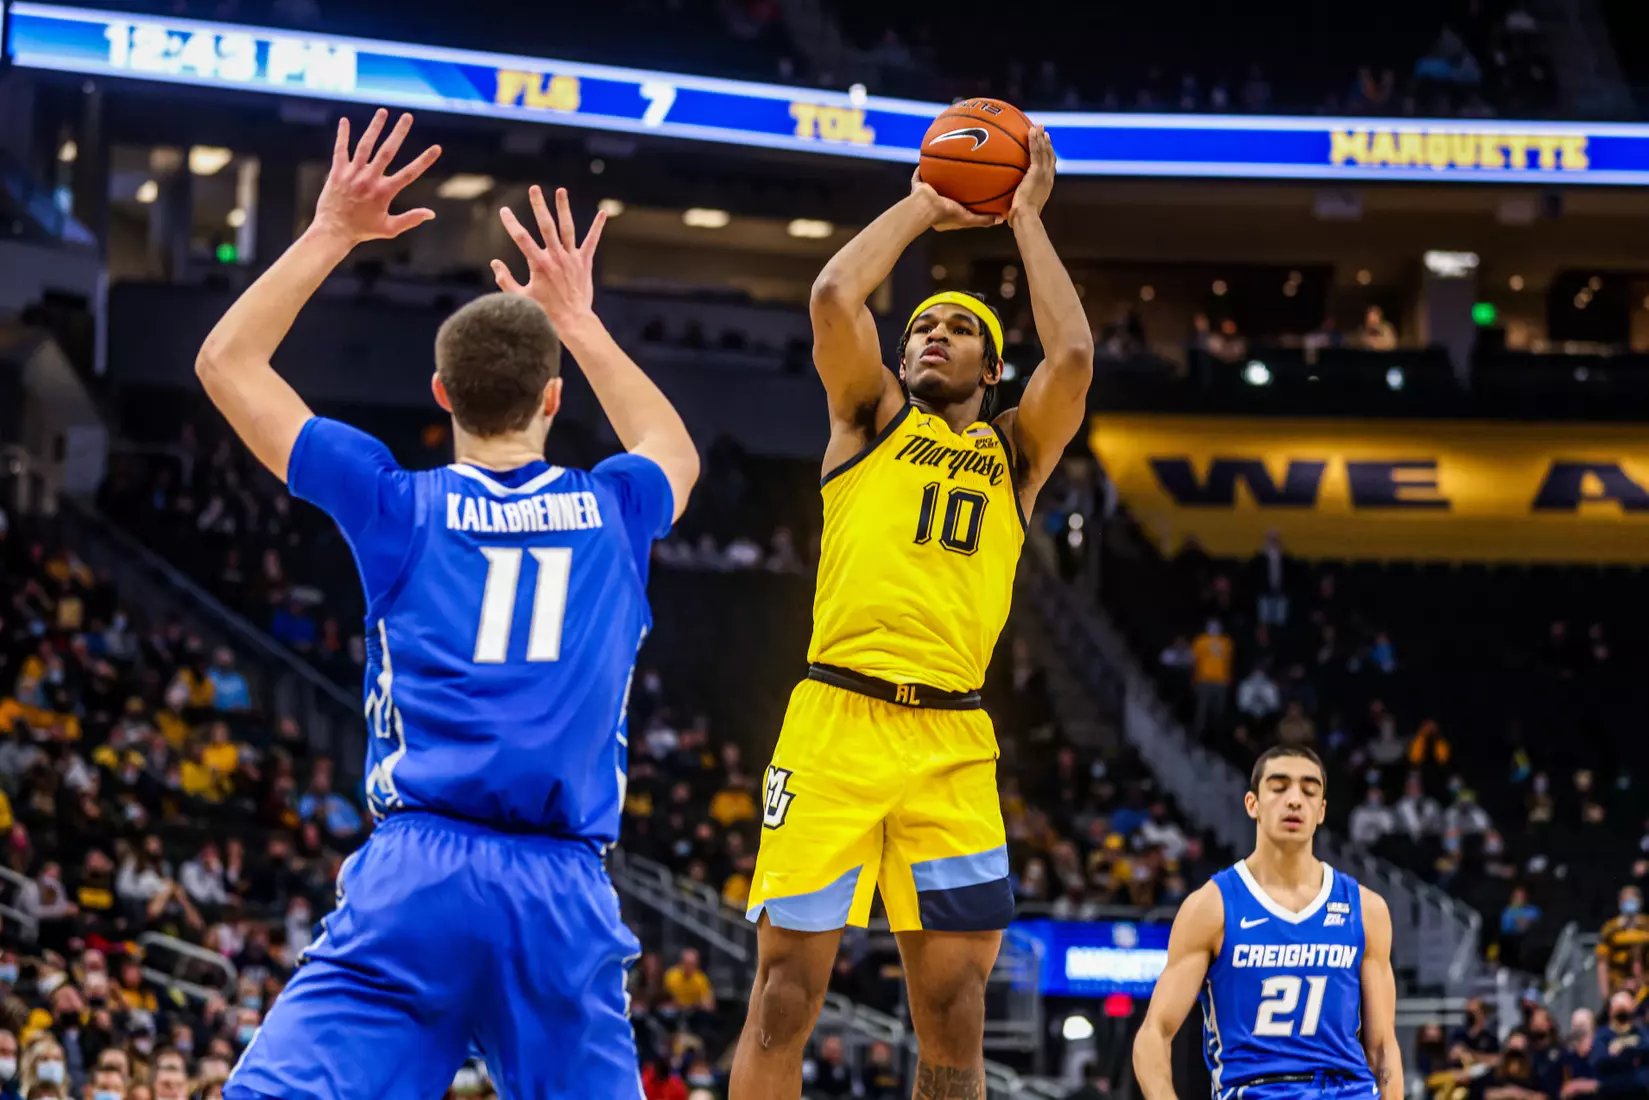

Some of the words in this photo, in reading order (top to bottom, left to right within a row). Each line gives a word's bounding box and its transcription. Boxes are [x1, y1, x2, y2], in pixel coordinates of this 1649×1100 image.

[104, 20, 257, 80] 12:43
[268, 36, 357, 93] PM
[638, 81, 677, 127] 7
[789, 103, 875, 144] TOL
[1330, 130, 1590, 170] MARQUETTE
[1146, 457, 1452, 512] WE
[447, 492, 603, 533] KALKBRENNER
[912, 481, 989, 557] 10
[472, 546, 573, 664] 11
[895, 685, 920, 706] AL
[1231, 943, 1358, 969] CREIGHTON
[1252, 974, 1328, 1037] 21
